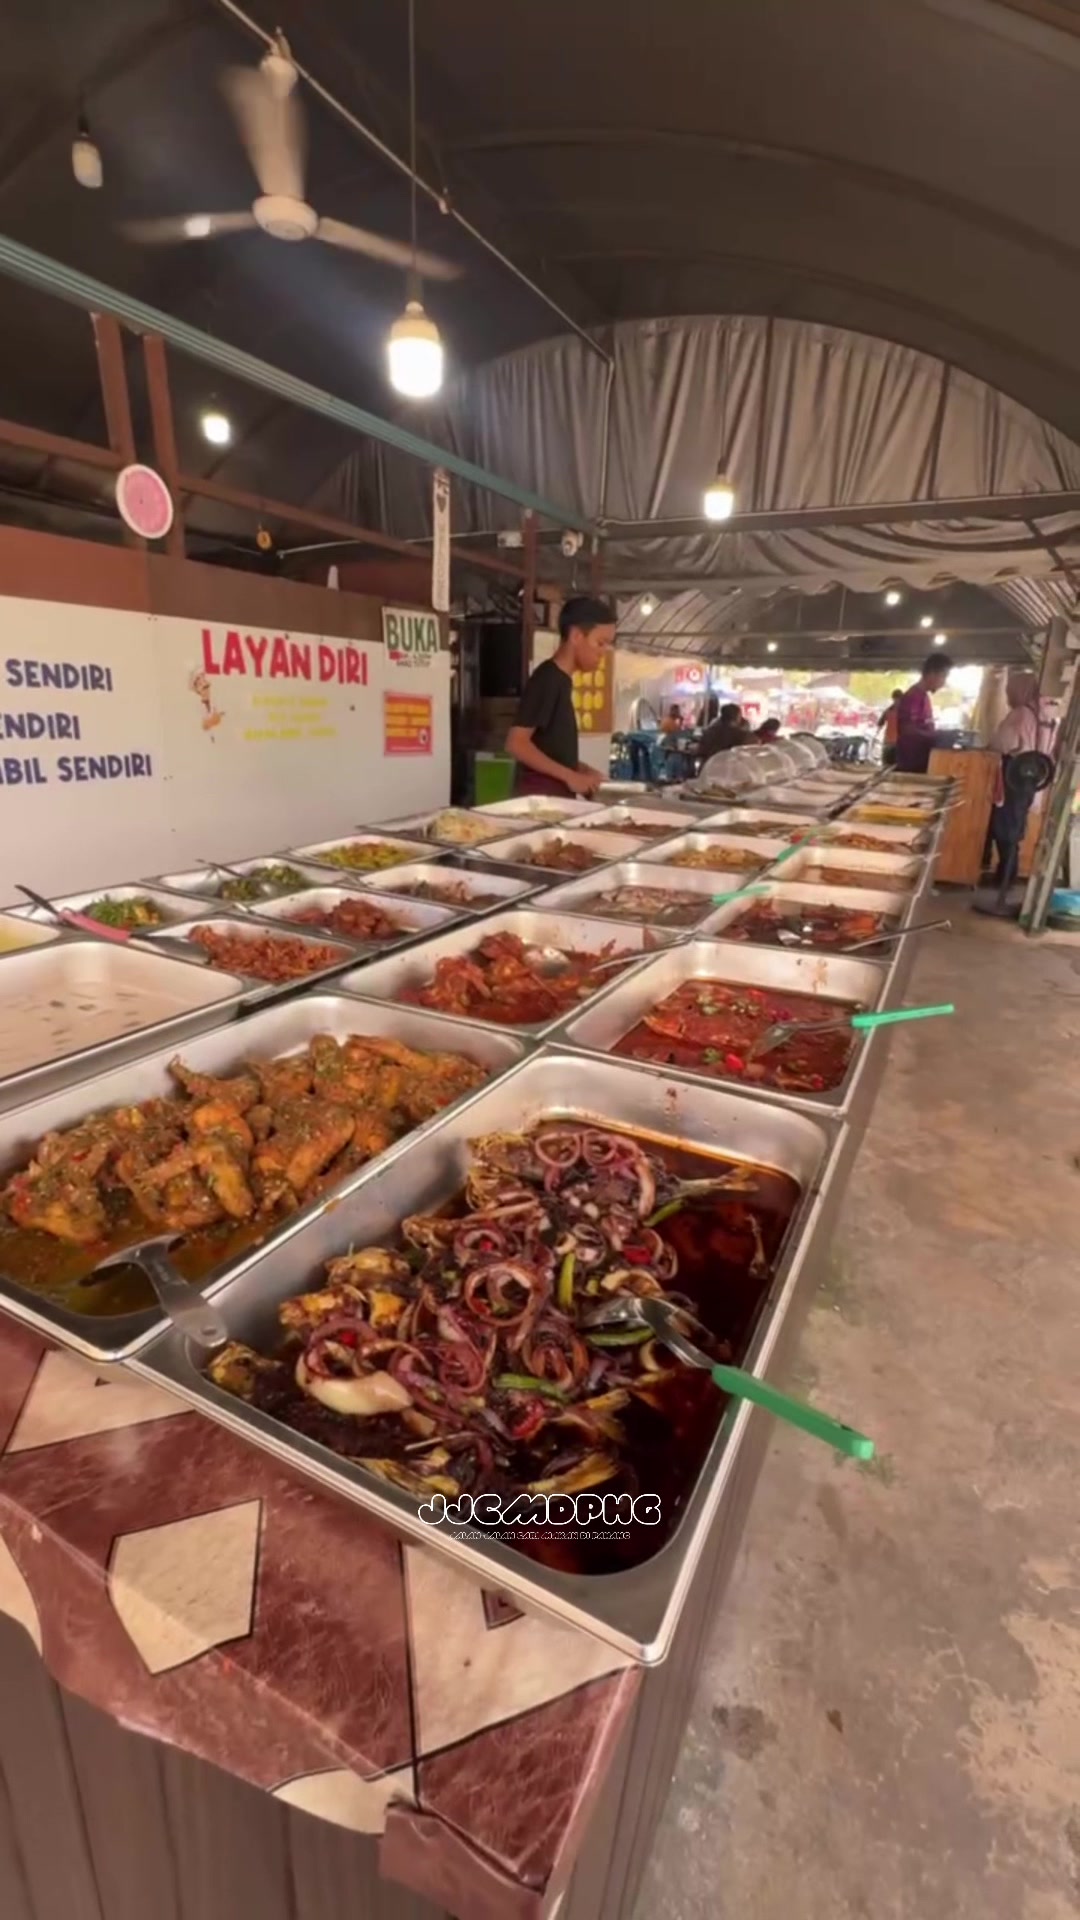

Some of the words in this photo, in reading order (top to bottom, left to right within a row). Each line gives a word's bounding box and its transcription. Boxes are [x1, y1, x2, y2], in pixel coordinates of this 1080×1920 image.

[385, 614, 438, 653] BUKA
[202, 629, 312, 681] LAYAN
[318, 644, 368, 686] DIRI
[5, 658, 113, 692] SENDIRI
[0, 712, 81, 740] NDIRI
[0, 756, 47, 785] BIL
[57, 752, 152, 782] SENDIRI
